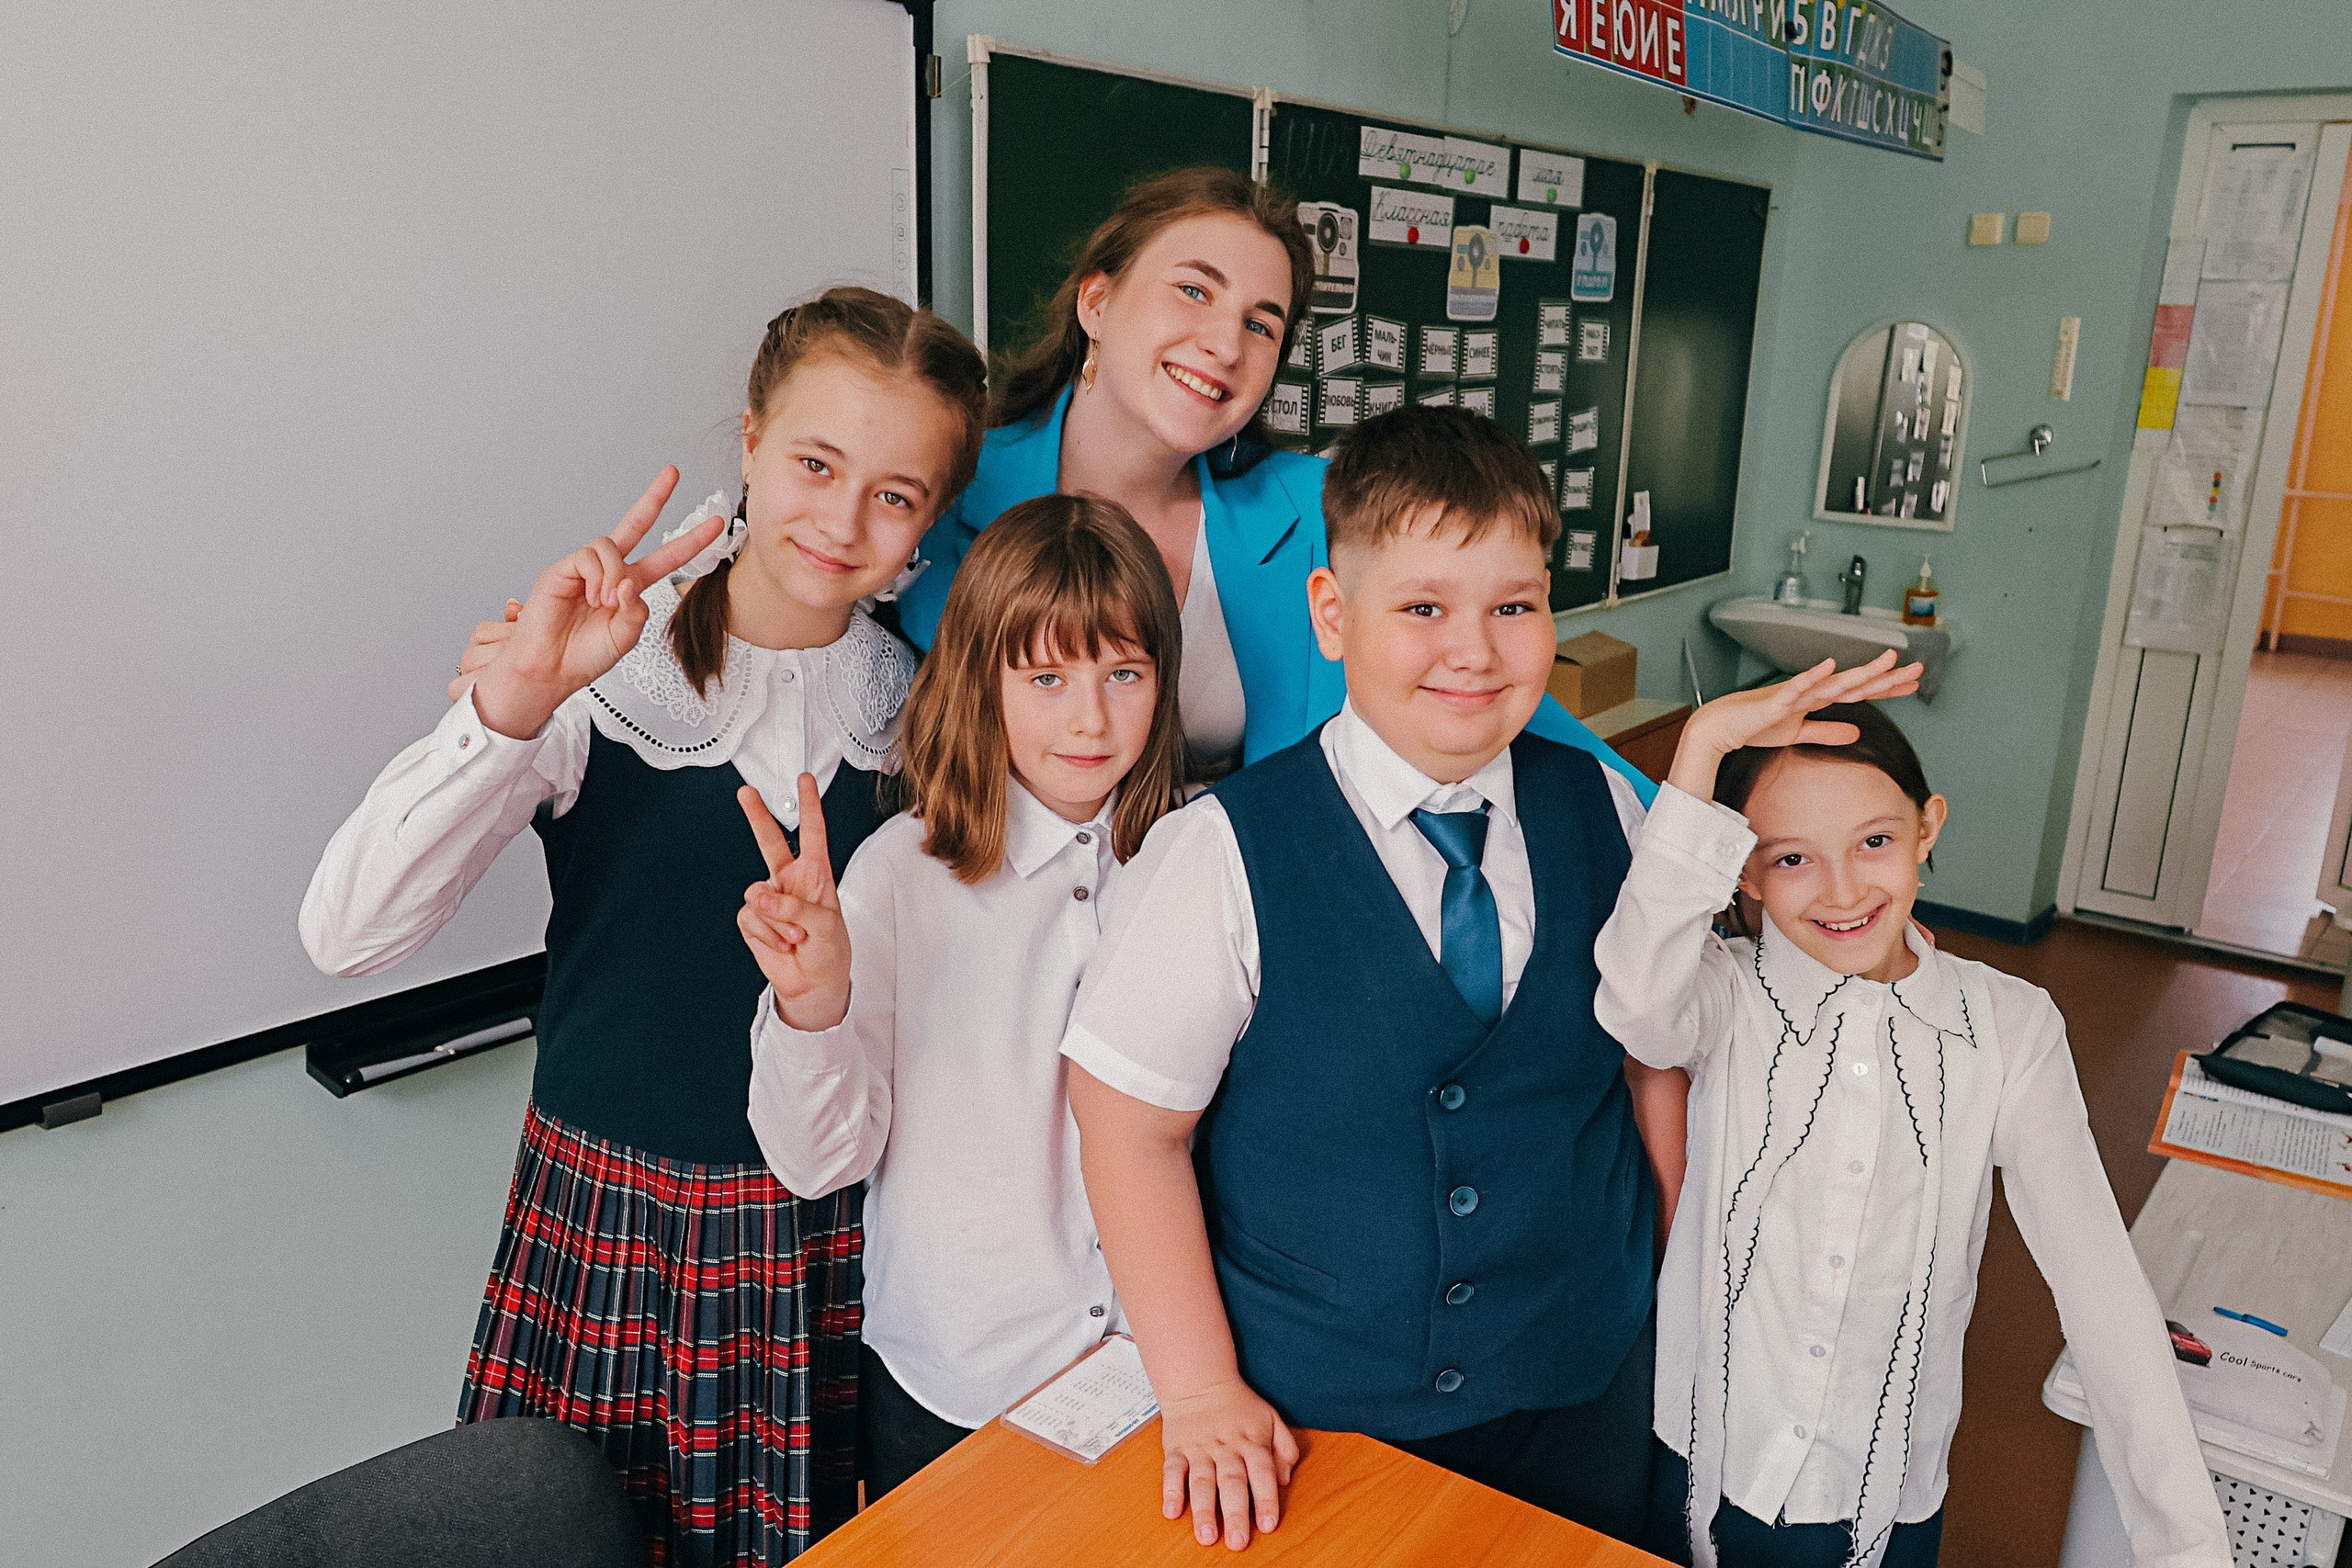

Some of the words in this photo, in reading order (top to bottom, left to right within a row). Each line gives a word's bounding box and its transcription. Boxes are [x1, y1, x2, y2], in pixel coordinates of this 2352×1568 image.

[1532, 169, 1564, 186] мая
[1372, 190, 1450, 227] Классная
[1331, 334, 1346, 353] БЕГ
[1374, 329, 1397, 344] МАЛЬ-
[1377, 349, 1392, 363] ЧИК
[1272, 399, 1297, 415] СТОЛ
[2220, 1351, 2248, 1367] Cool
